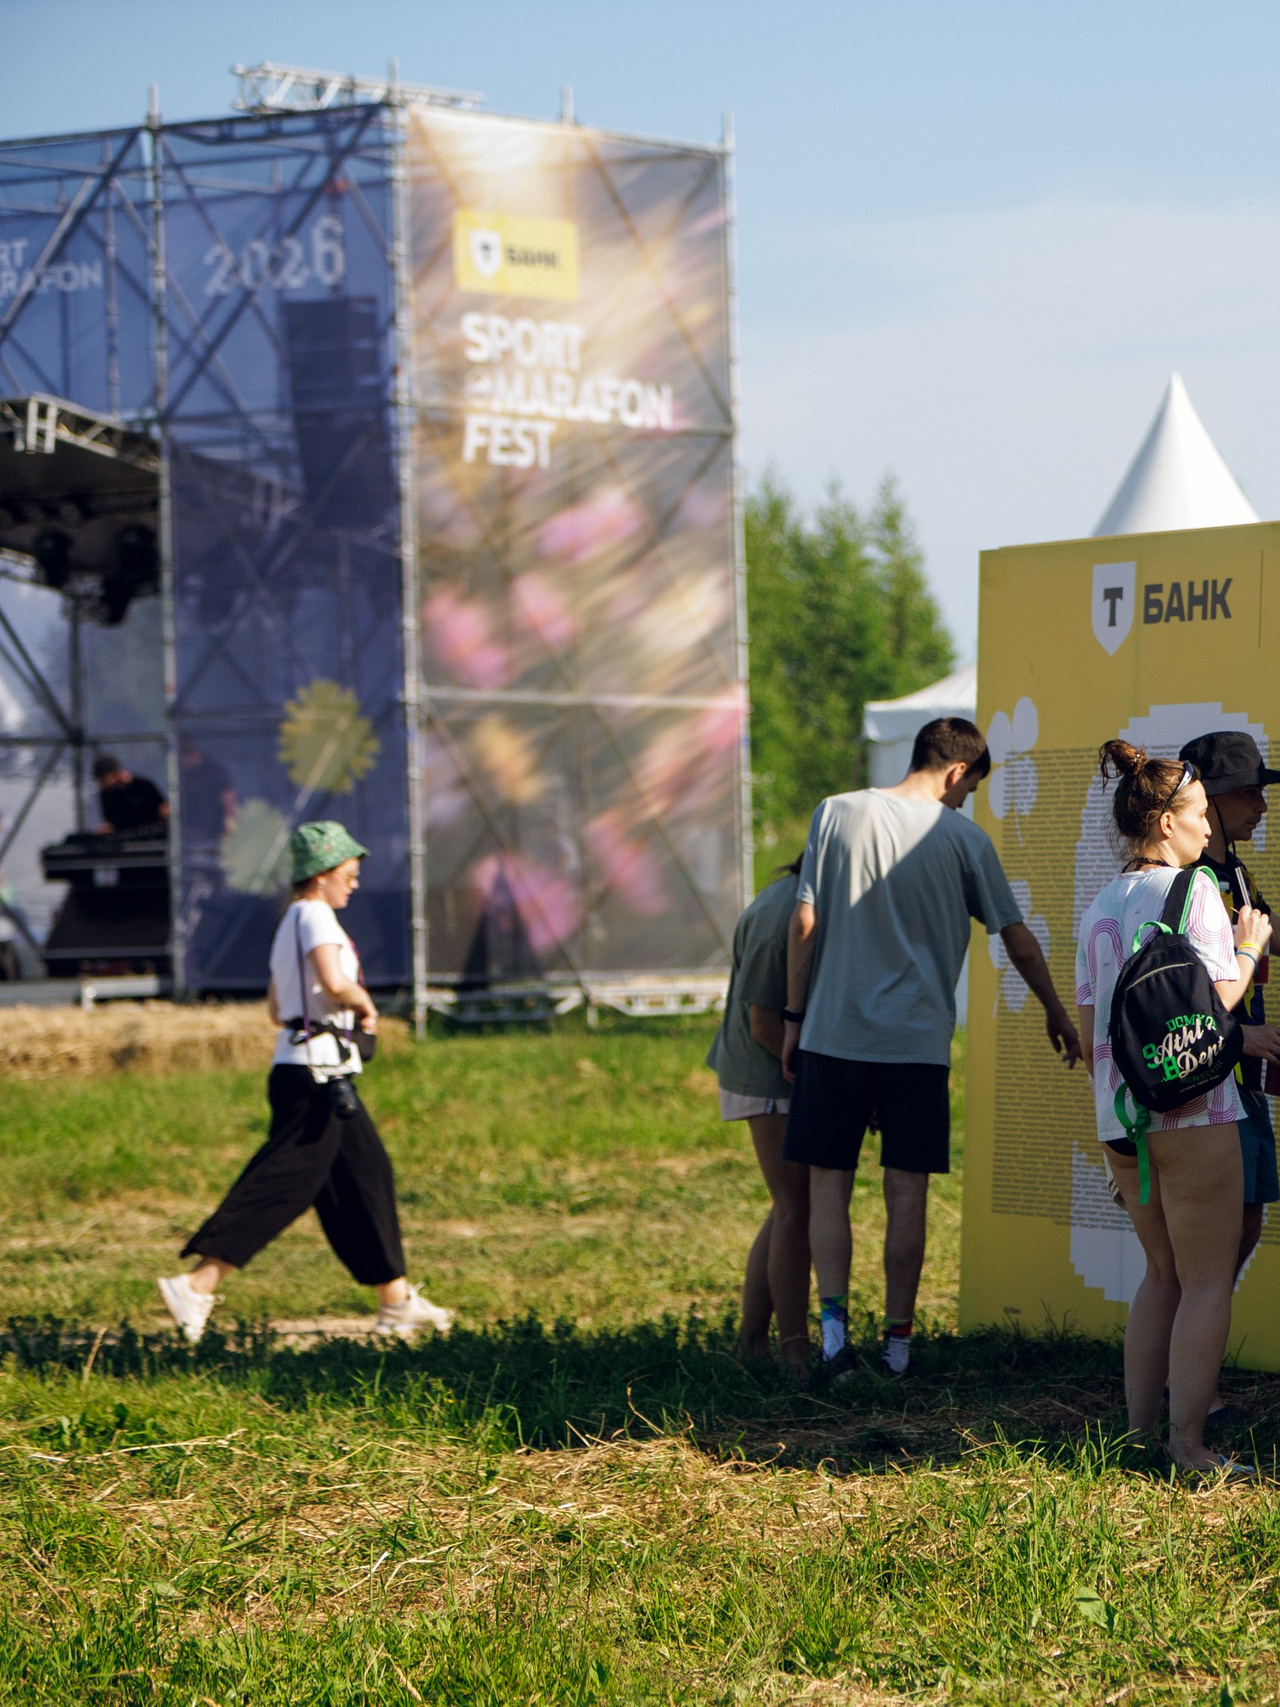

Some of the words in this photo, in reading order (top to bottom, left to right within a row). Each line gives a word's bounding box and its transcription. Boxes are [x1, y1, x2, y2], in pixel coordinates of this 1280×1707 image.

[202, 214, 345, 297] 2026
[460, 312, 584, 370] SPORT
[491, 369, 674, 430] MARAFON
[462, 413, 555, 468] FEST
[1143, 578, 1233, 624] БАНК
